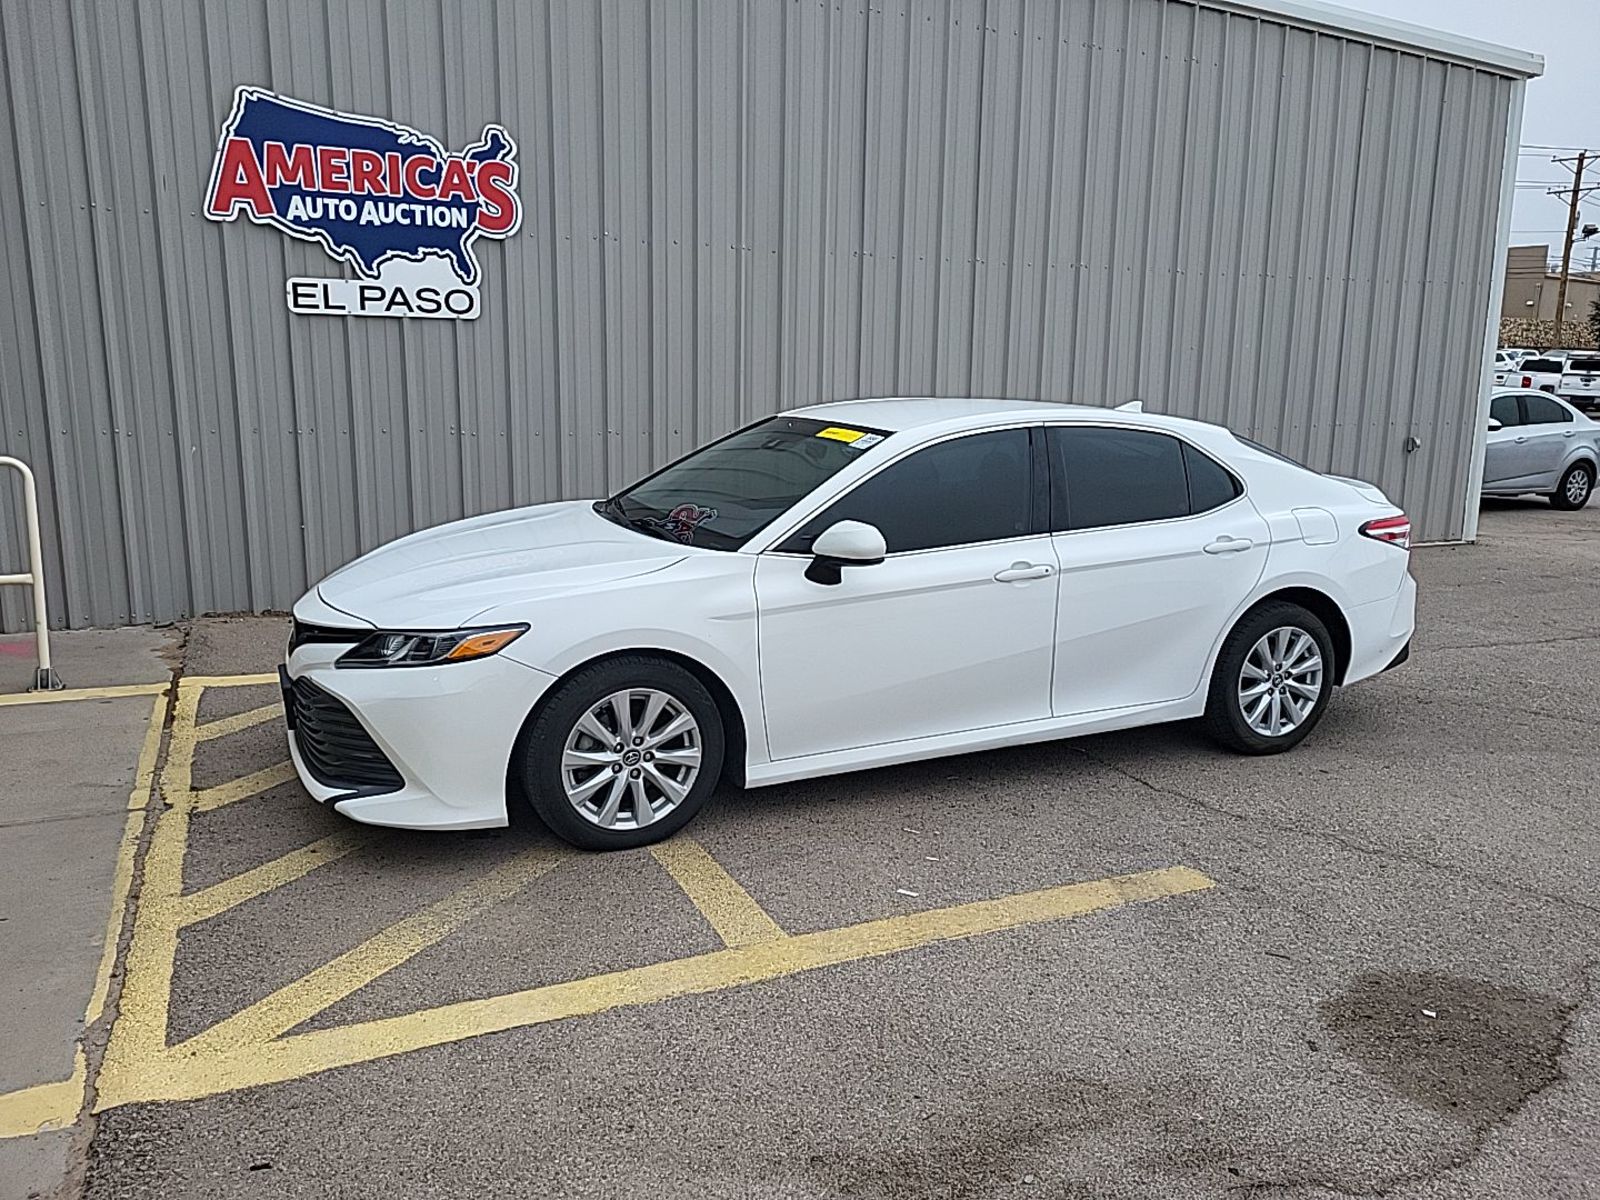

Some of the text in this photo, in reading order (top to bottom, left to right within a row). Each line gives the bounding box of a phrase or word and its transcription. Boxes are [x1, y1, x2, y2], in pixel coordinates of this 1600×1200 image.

[211, 137, 516, 231] AMERICA'S
[287, 195, 468, 228] AUTO AUCTION
[291, 282, 474, 314] EL PASO
